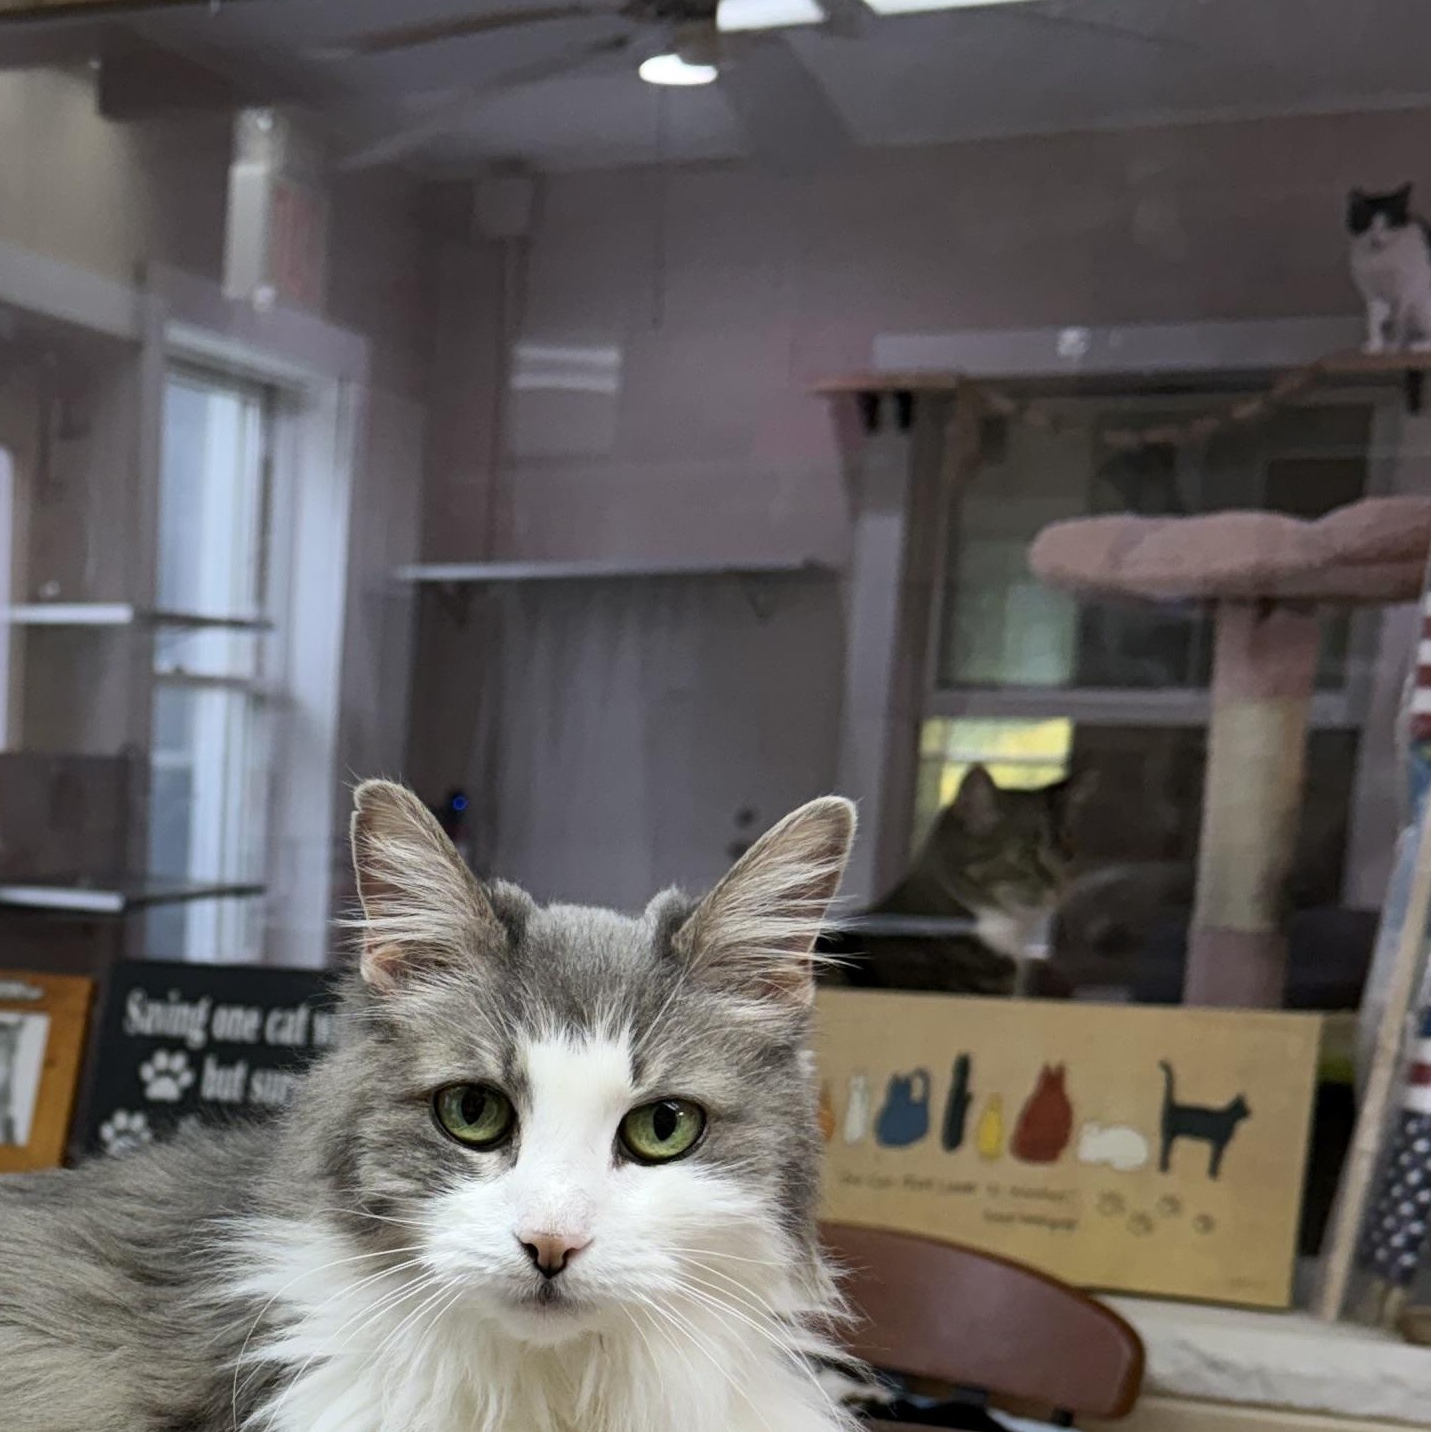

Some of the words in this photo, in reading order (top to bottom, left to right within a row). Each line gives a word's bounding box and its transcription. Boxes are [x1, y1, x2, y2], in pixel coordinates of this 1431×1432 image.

[123, 987, 211, 1049] Saving
[212, 1003, 262, 1043] one
[264, 1000, 310, 1047] cat
[201, 1053, 249, 1103] but
[249, 1066, 291, 1104] sur
